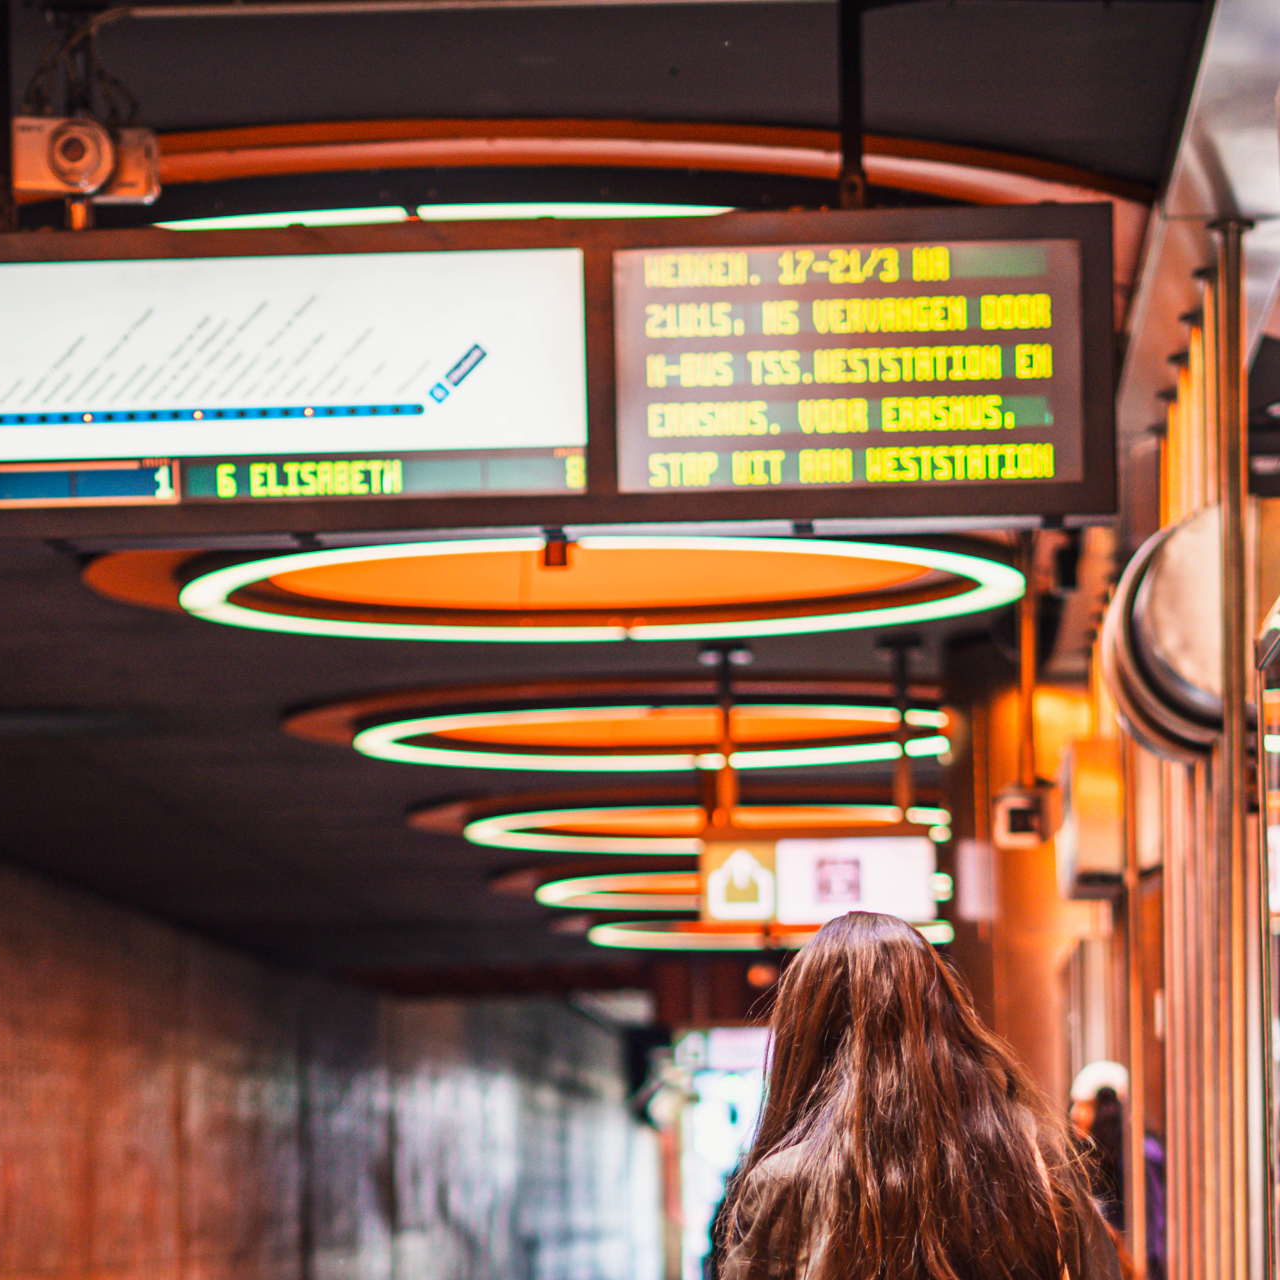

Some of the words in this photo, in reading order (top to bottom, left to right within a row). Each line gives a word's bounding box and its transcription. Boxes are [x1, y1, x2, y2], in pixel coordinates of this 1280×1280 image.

[778, 248, 899, 284] 17-21/3
[812, 296, 967, 334] VERVANGEN
[980, 293, 1052, 330] DOOR
[1015, 344, 1053, 379] EN
[798, 398, 868, 434] VOOR
[153, 464, 174, 500] 1
[216, 463, 236, 499] 6
[249, 459, 403, 498] ELISABETH
[648, 451, 718, 487] STAP
[731, 449, 785, 485] UIT
[799, 448, 853, 483] AAN
[865, 443, 1054, 482] WESTSTATION
